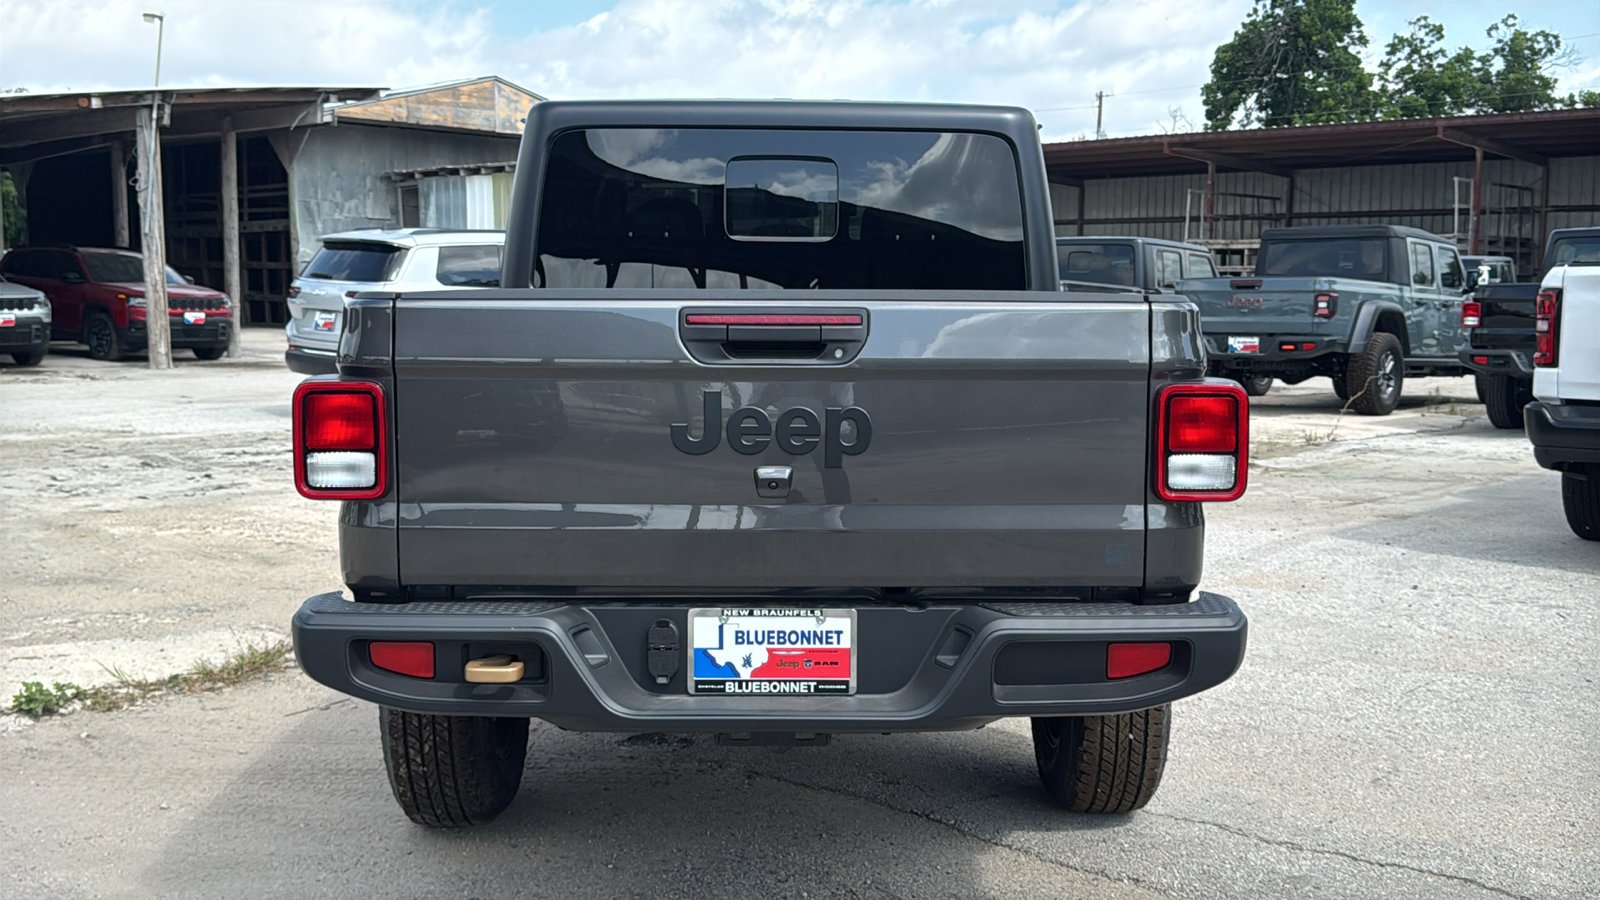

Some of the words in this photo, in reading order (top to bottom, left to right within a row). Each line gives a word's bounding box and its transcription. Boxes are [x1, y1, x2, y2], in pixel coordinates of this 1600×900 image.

[670, 389, 872, 469] Jeep
[754, 609, 822, 617] BRAUNFELS
[734, 630, 843, 645] BLUEBONNET
[776, 659, 800, 669] Jeep
[725, 681, 817, 693] BLUEBONNET
